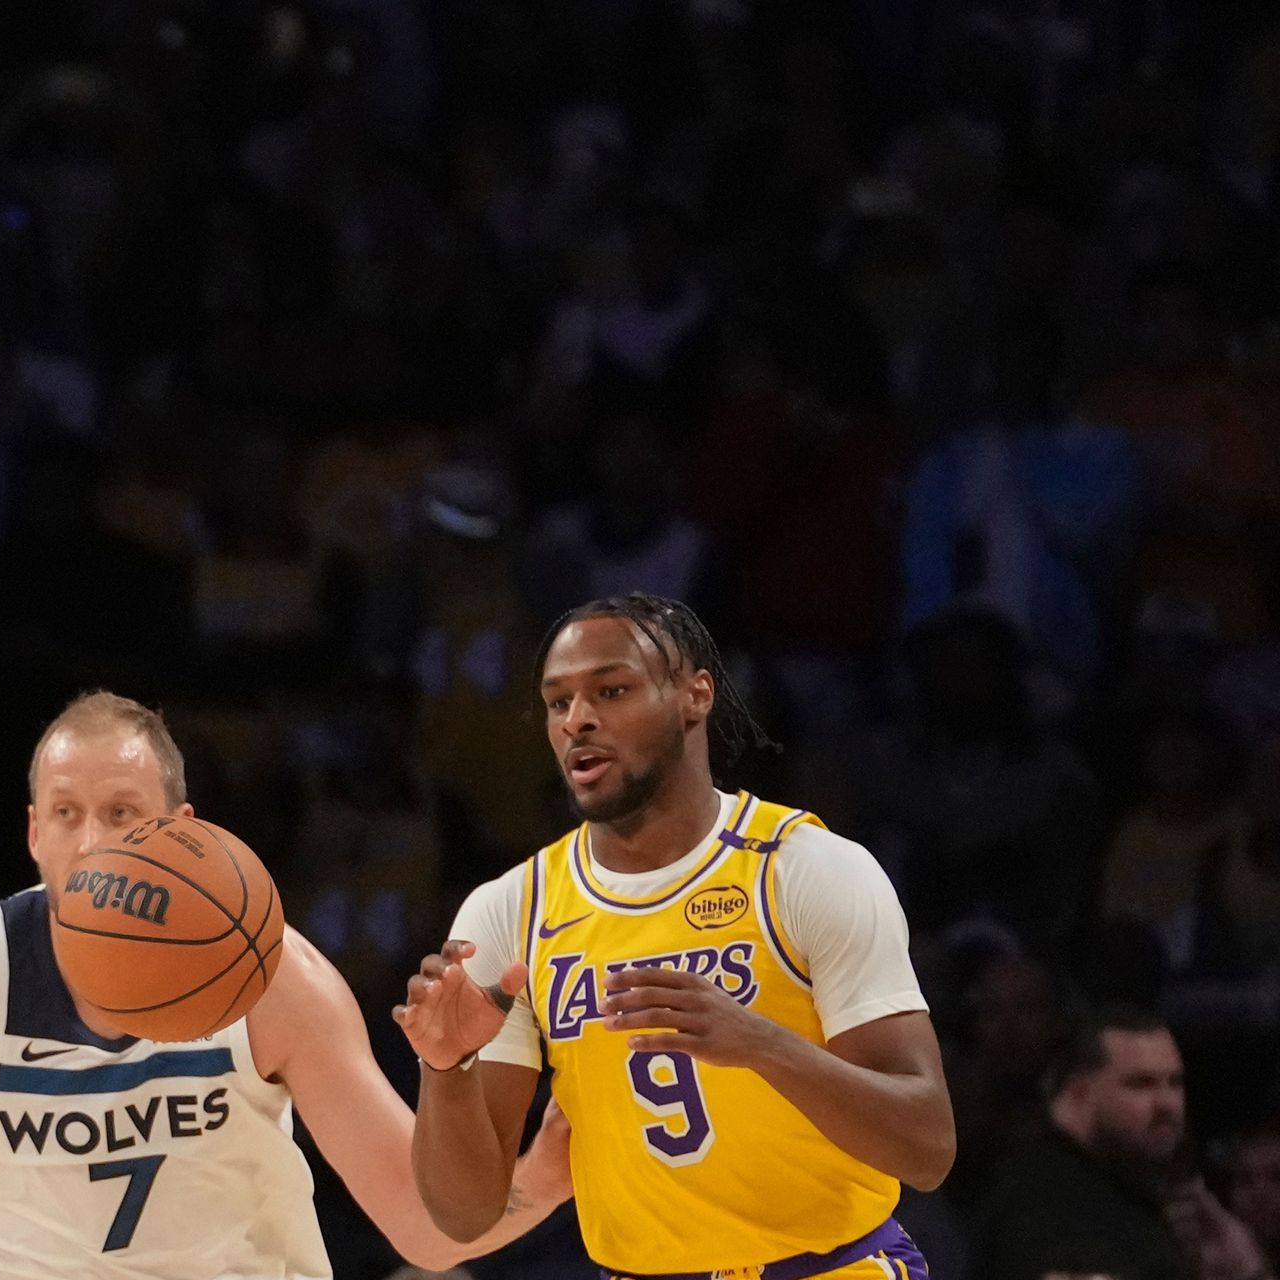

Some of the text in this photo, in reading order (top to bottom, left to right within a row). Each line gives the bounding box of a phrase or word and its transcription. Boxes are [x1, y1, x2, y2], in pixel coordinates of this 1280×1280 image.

[64, 869, 171, 926] Wilson
[690, 897, 745, 915] bibigo
[625, 1048, 717, 1169] 9
[87, 1153, 168, 1254] 7
